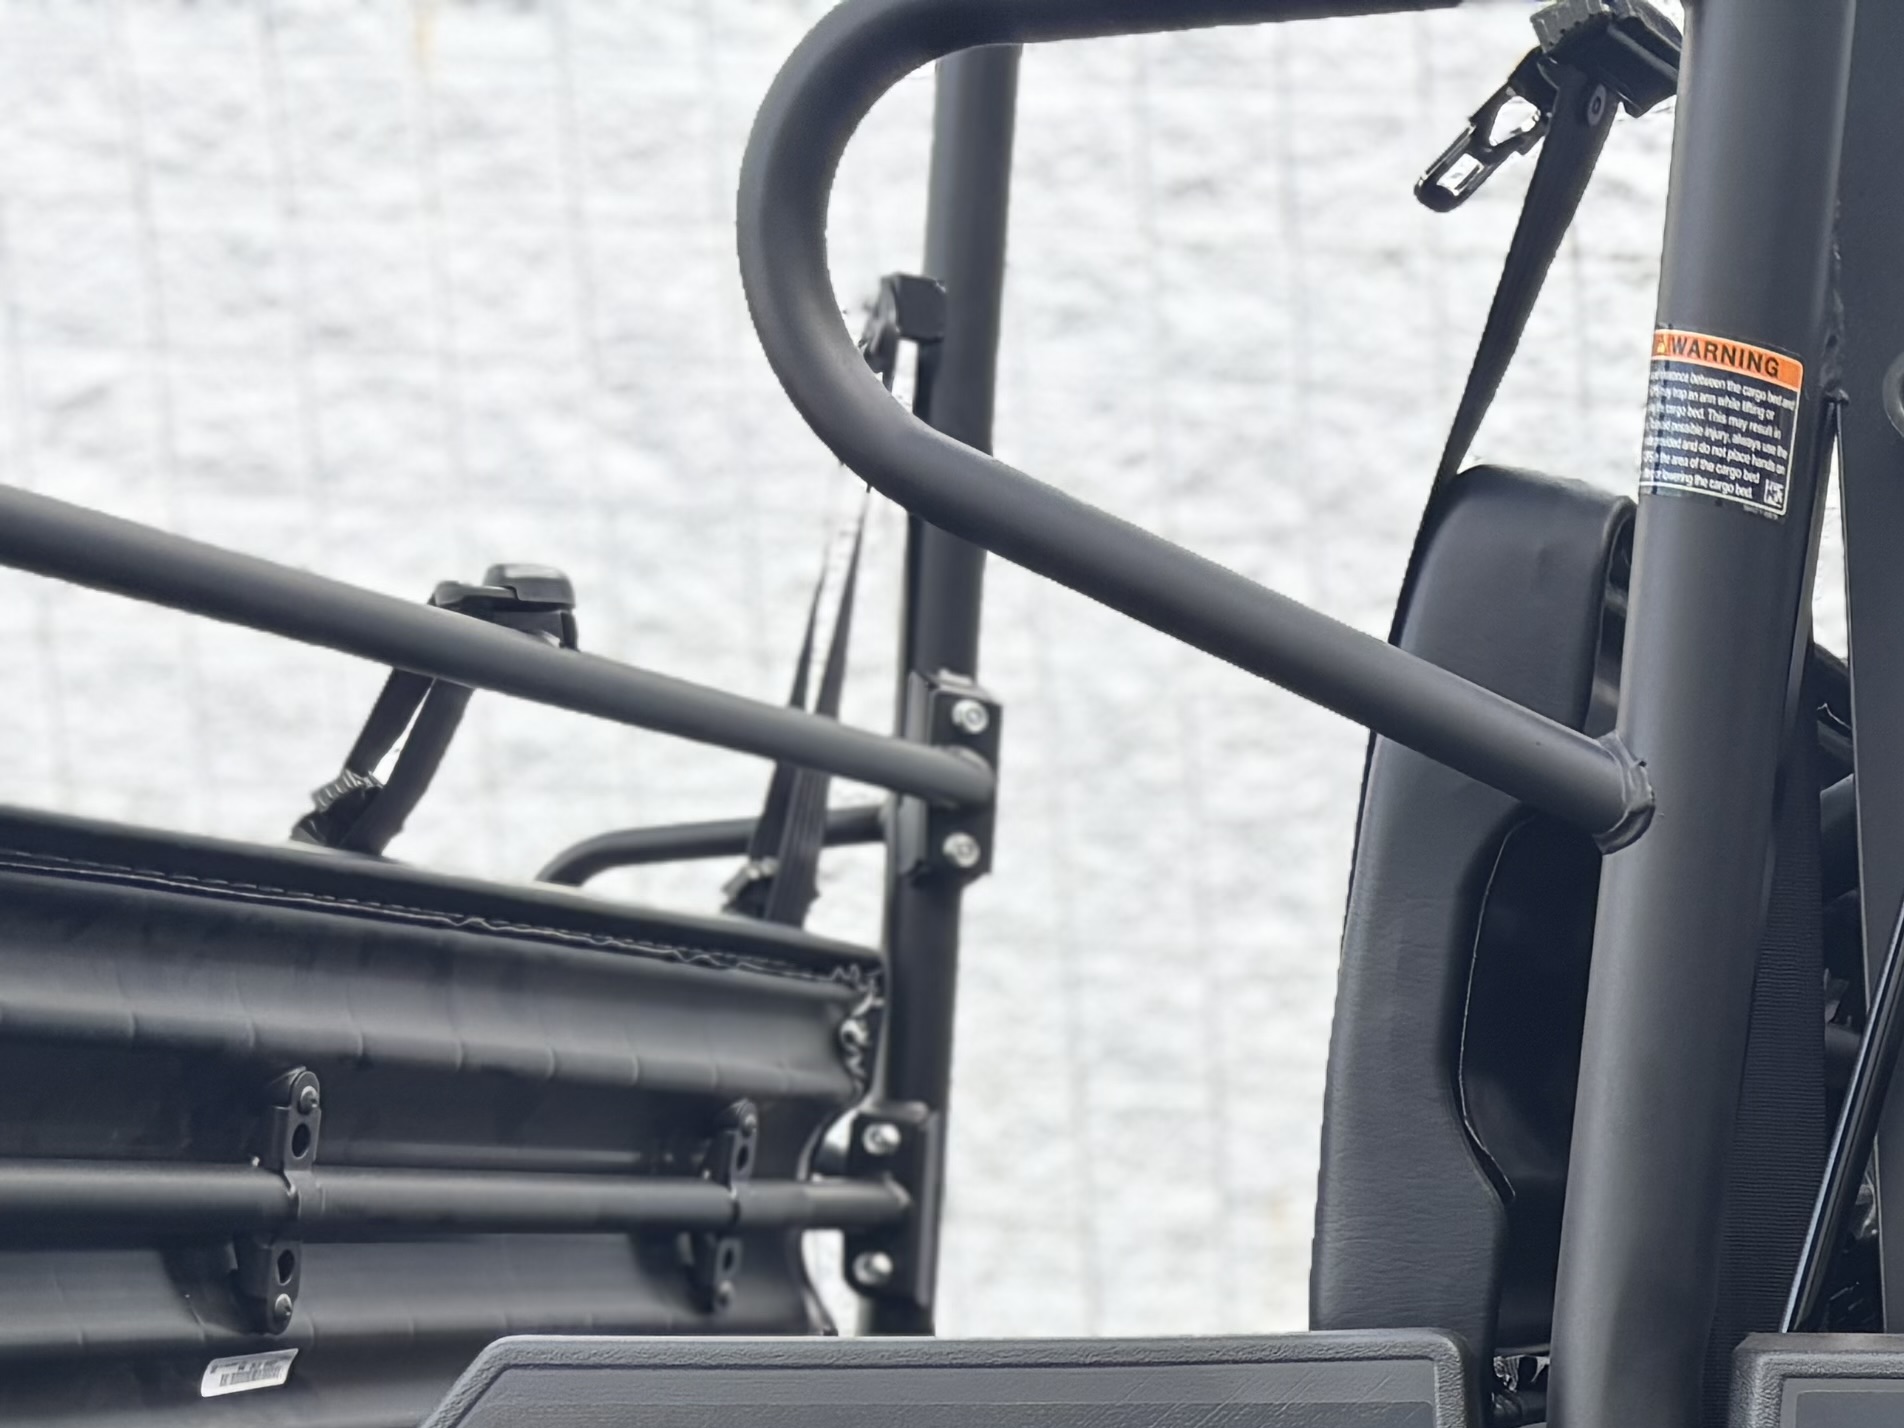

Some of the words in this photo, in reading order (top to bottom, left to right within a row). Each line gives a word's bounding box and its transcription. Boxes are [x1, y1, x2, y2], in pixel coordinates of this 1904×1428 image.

[1672, 335, 1779, 378] WARNING
[1690, 371, 1725, 388] between
[1726, 380, 1741, 394] the
[1742, 386, 1766, 402] cargo
[1717, 395, 1741, 411] while
[1742, 399, 1765, 419] lifting
[1765, 410, 1775, 420] or
[1707, 410, 1727, 424] This
[1728, 416, 1749, 432] may
[1749, 421, 1773, 438] result
[1774, 429, 1781, 439] in
[1682, 440, 1698, 453] and
[1699, 442, 1711, 454] do
[1712, 445, 1727, 457] not
[1727, 450, 1751, 462] place
[1751, 453, 1775, 472] hands
[1732, 432, 1761, 452] always
[1777, 444, 1788, 460] the
[1672, 455, 1688, 467] area
[1689, 457, 1700, 470] of
[1700, 459, 1715, 472] the
[1716, 463, 1742, 480] cargo
[1743, 469, 1760, 484] bed
[1694, 475, 1708, 487] the
[1709, 479, 1734, 495] cargo
